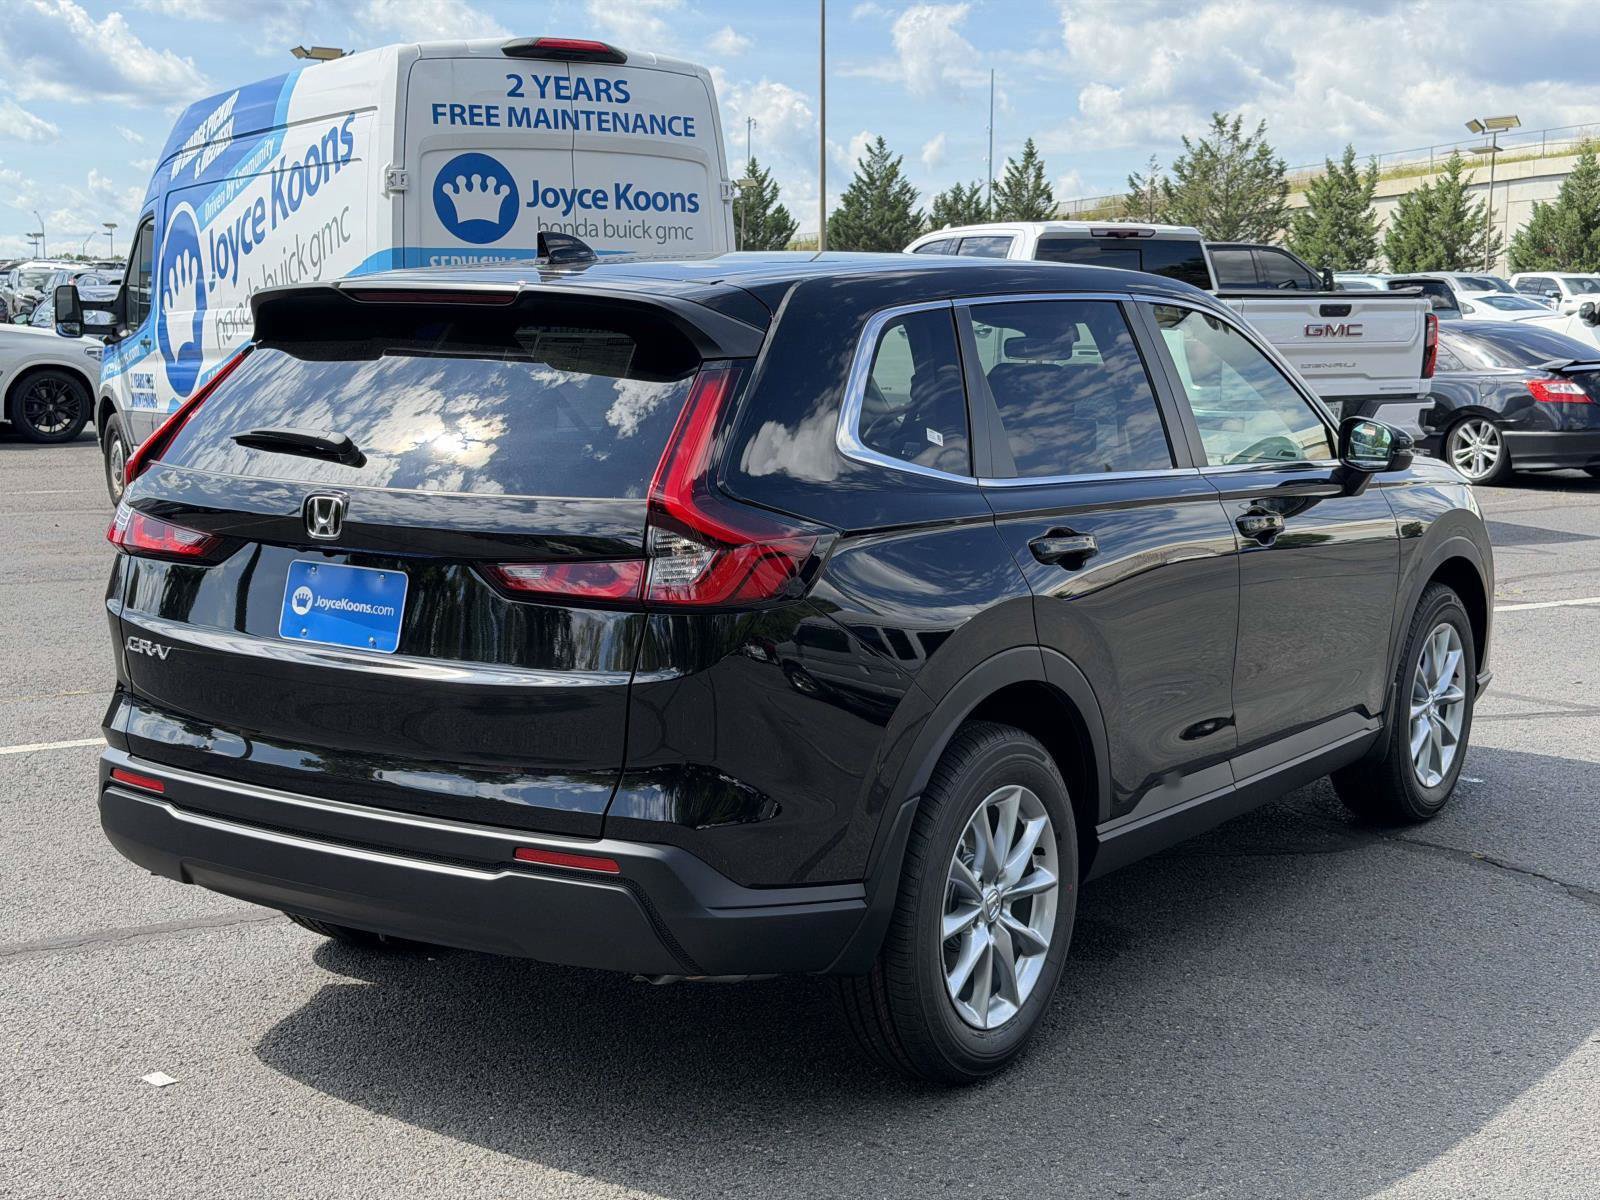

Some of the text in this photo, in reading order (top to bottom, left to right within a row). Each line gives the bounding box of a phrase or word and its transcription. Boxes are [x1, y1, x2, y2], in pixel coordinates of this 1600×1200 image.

[506, 74, 631, 104] 2 YEARS
[431, 103, 696, 138] FREE MAINTENANCE
[208, 111, 356, 294] Joyce Koons
[526, 179, 700, 217] Joyce Koons
[310, 205, 352, 282] gmc
[603, 218, 653, 239] buick
[655, 223, 694, 245] gmc
[1304, 324, 1364, 338] GMC
[315, 595, 395, 617] JoyceKoons.com
[127, 636, 172, 660] CR-V
